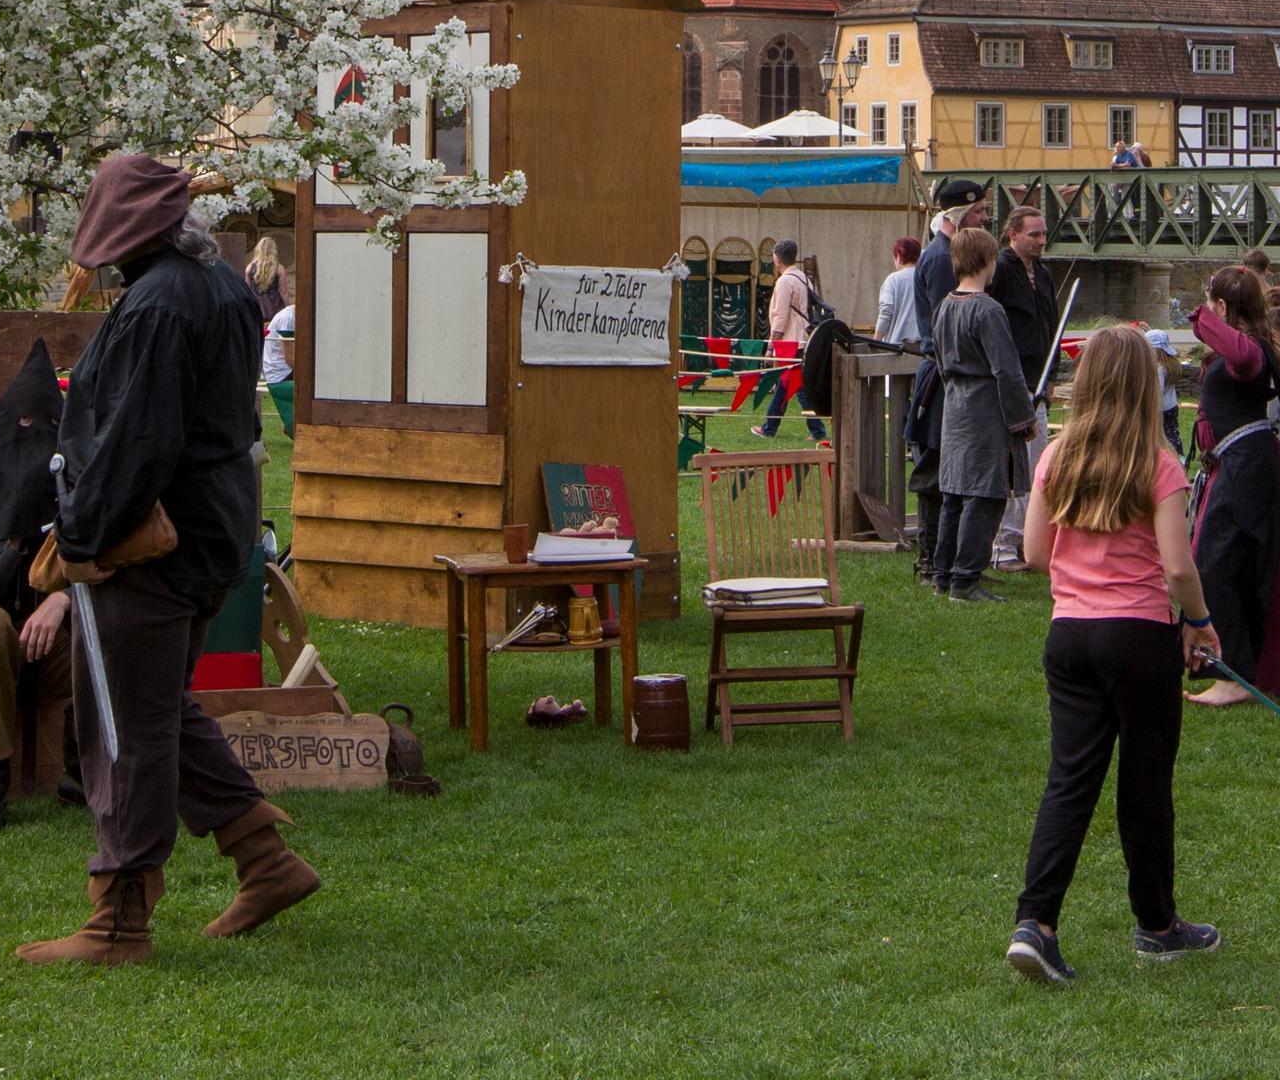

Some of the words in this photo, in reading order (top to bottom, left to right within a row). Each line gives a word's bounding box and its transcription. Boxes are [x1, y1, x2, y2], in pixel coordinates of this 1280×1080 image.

[576, 274, 599, 295] für
[600, 273, 614, 297] 2
[614, 274, 647, 299] Taler
[535, 287, 666, 344] Kinderkampfarena
[561, 484, 616, 511] RITTER
